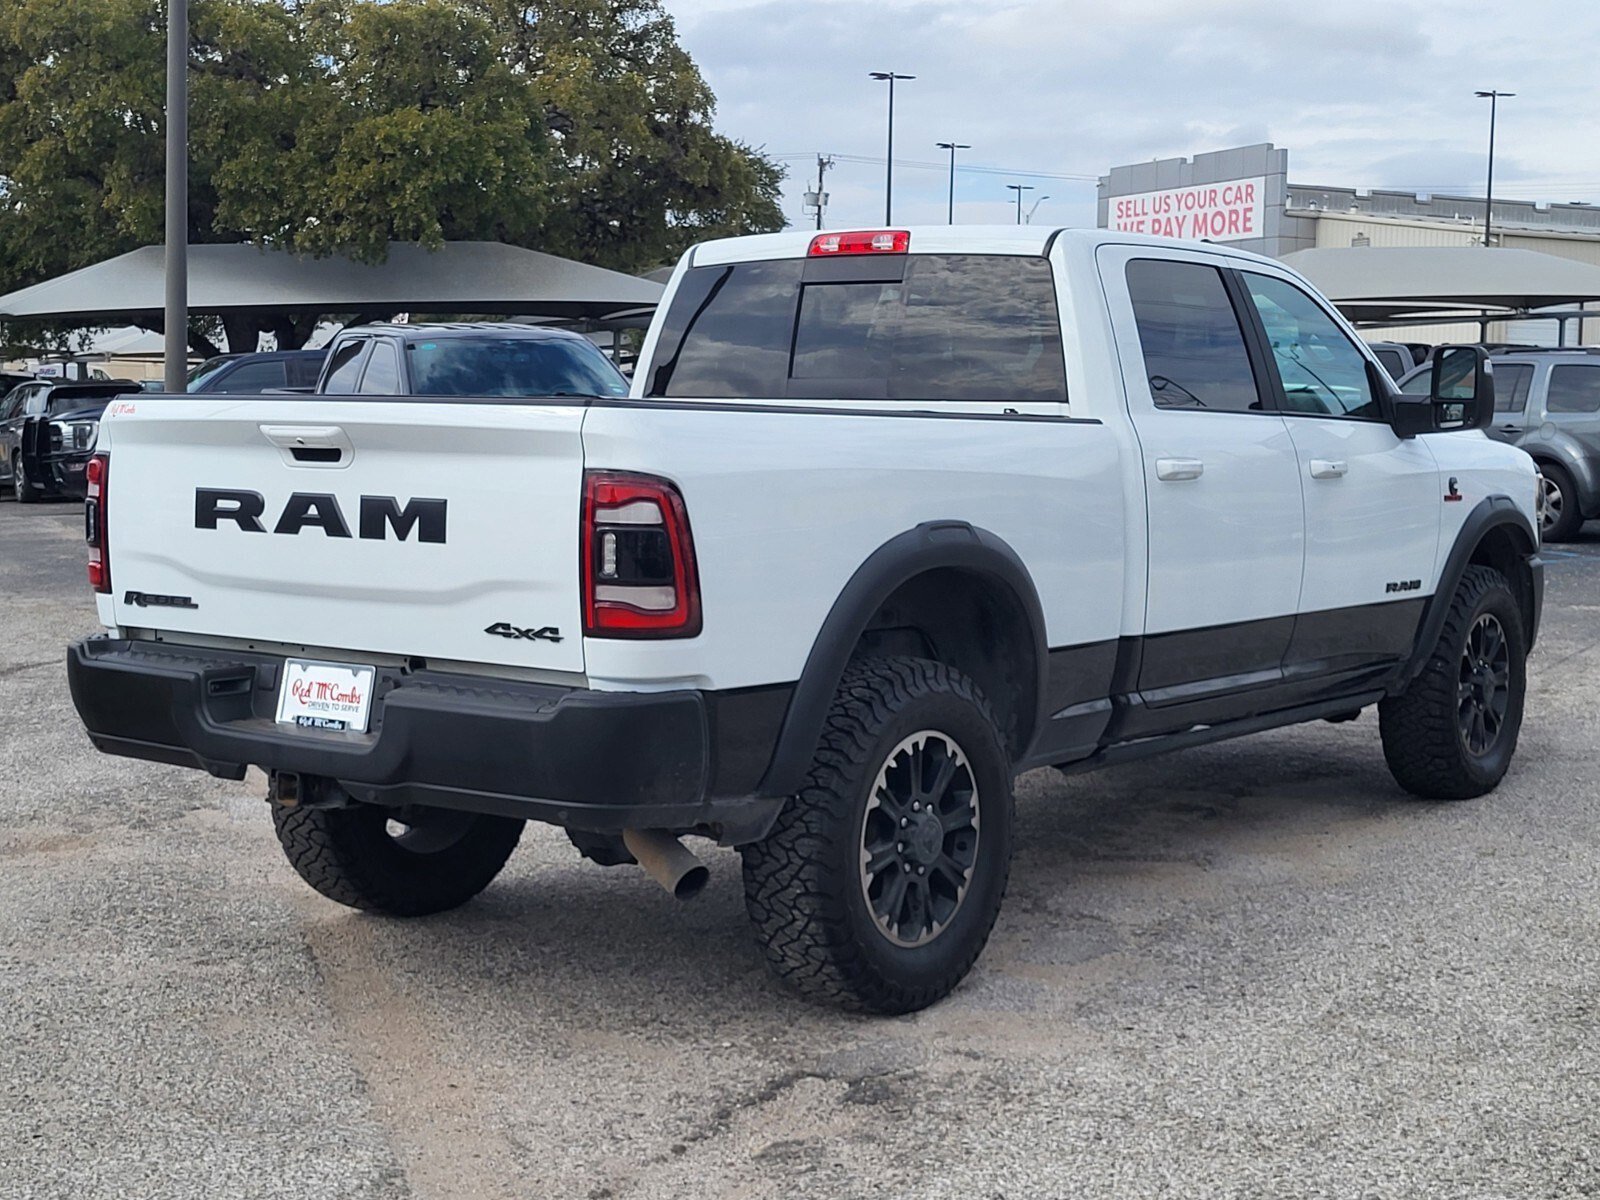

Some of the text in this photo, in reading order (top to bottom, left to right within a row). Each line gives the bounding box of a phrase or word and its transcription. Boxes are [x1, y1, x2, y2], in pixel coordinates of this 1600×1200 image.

[1117, 184, 1255, 219] SELL US YOUR CAR
[1151, 215, 1187, 238] PAY
[1192, 207, 1253, 238] MORE
[195, 487, 447, 544] RAM
[1385, 580, 1421, 593] RAM
[484, 622, 564, 643] 4x4
[292, 678, 313, 705] Red
[308, 701, 360, 713] DRIVEN TO SERVE
